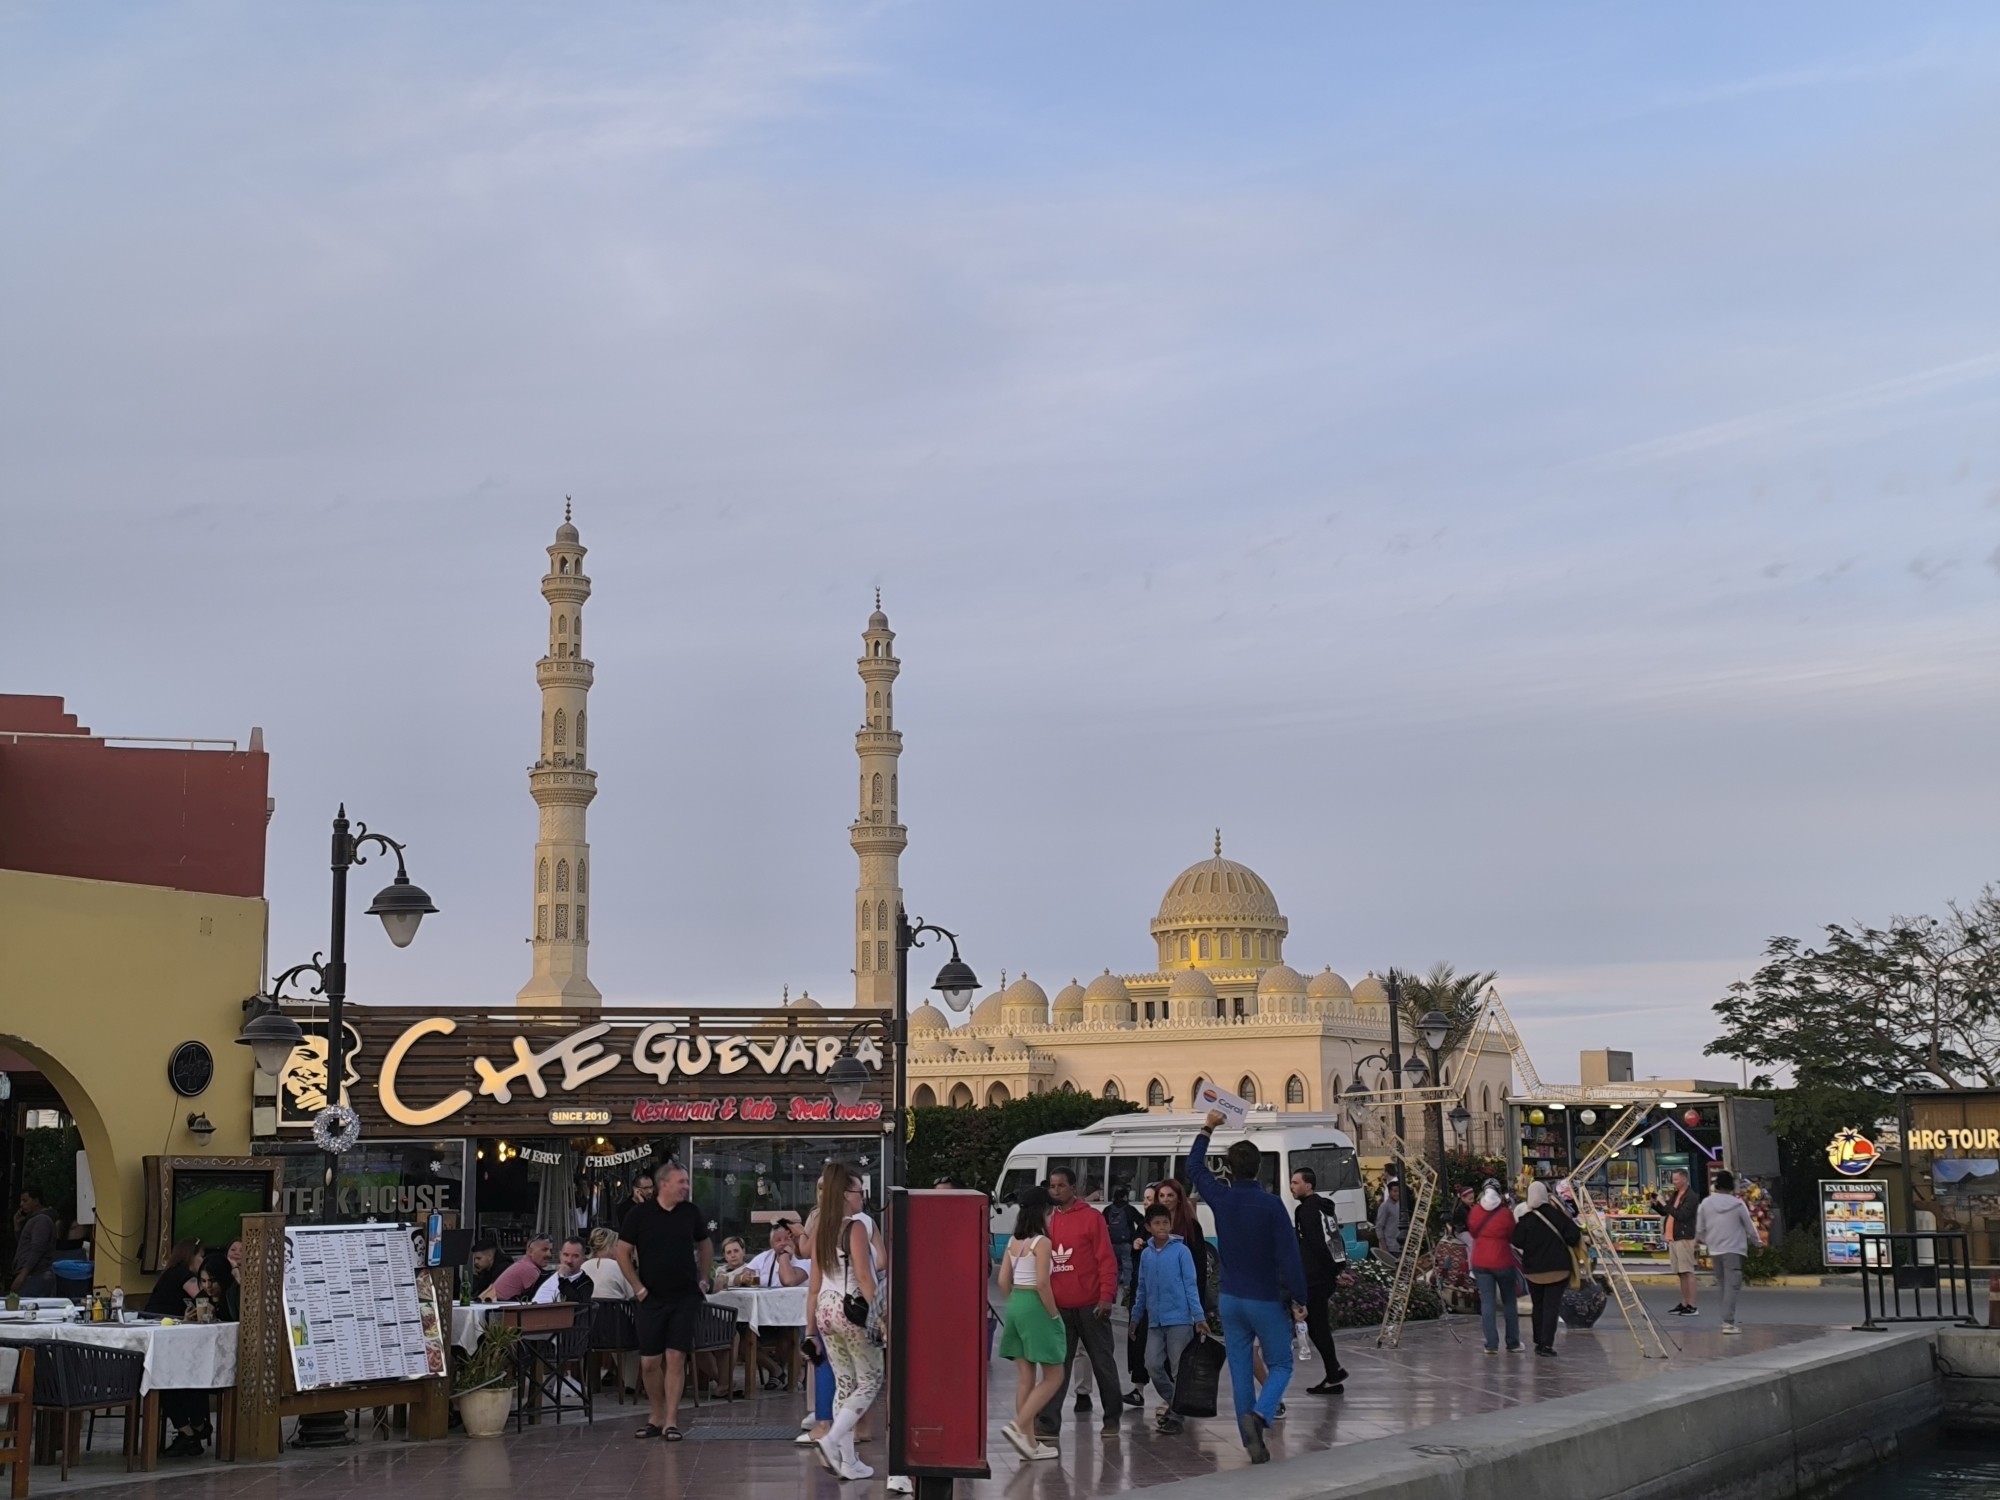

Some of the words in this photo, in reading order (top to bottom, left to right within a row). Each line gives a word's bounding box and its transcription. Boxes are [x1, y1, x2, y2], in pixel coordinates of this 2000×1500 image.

[378, 1018, 622, 1126] CHE
[632, 1022, 883, 1085] GUEVARA
[551, 1112, 583, 1121] SINCE
[585, 1112, 609, 1121] 2010
[632, 1098, 718, 1122] Restaurant
[720, 1097, 737, 1121] &
[740, 1096, 777, 1121] Cafe
[787, 1096, 833, 1121] Steak
[1218, 1098, 1244, 1116] Coral
[1908, 1129, 1947, 1150] HRG
[519, 1146, 562, 1165] MERRY
[585, 1143, 653, 1168] CHRISTMAS
[1825, 1184, 1883, 1192] EXCURSIONS
[282, 1186, 350, 1215] TEAK
[361, 1185, 450, 1214] HOUSE
